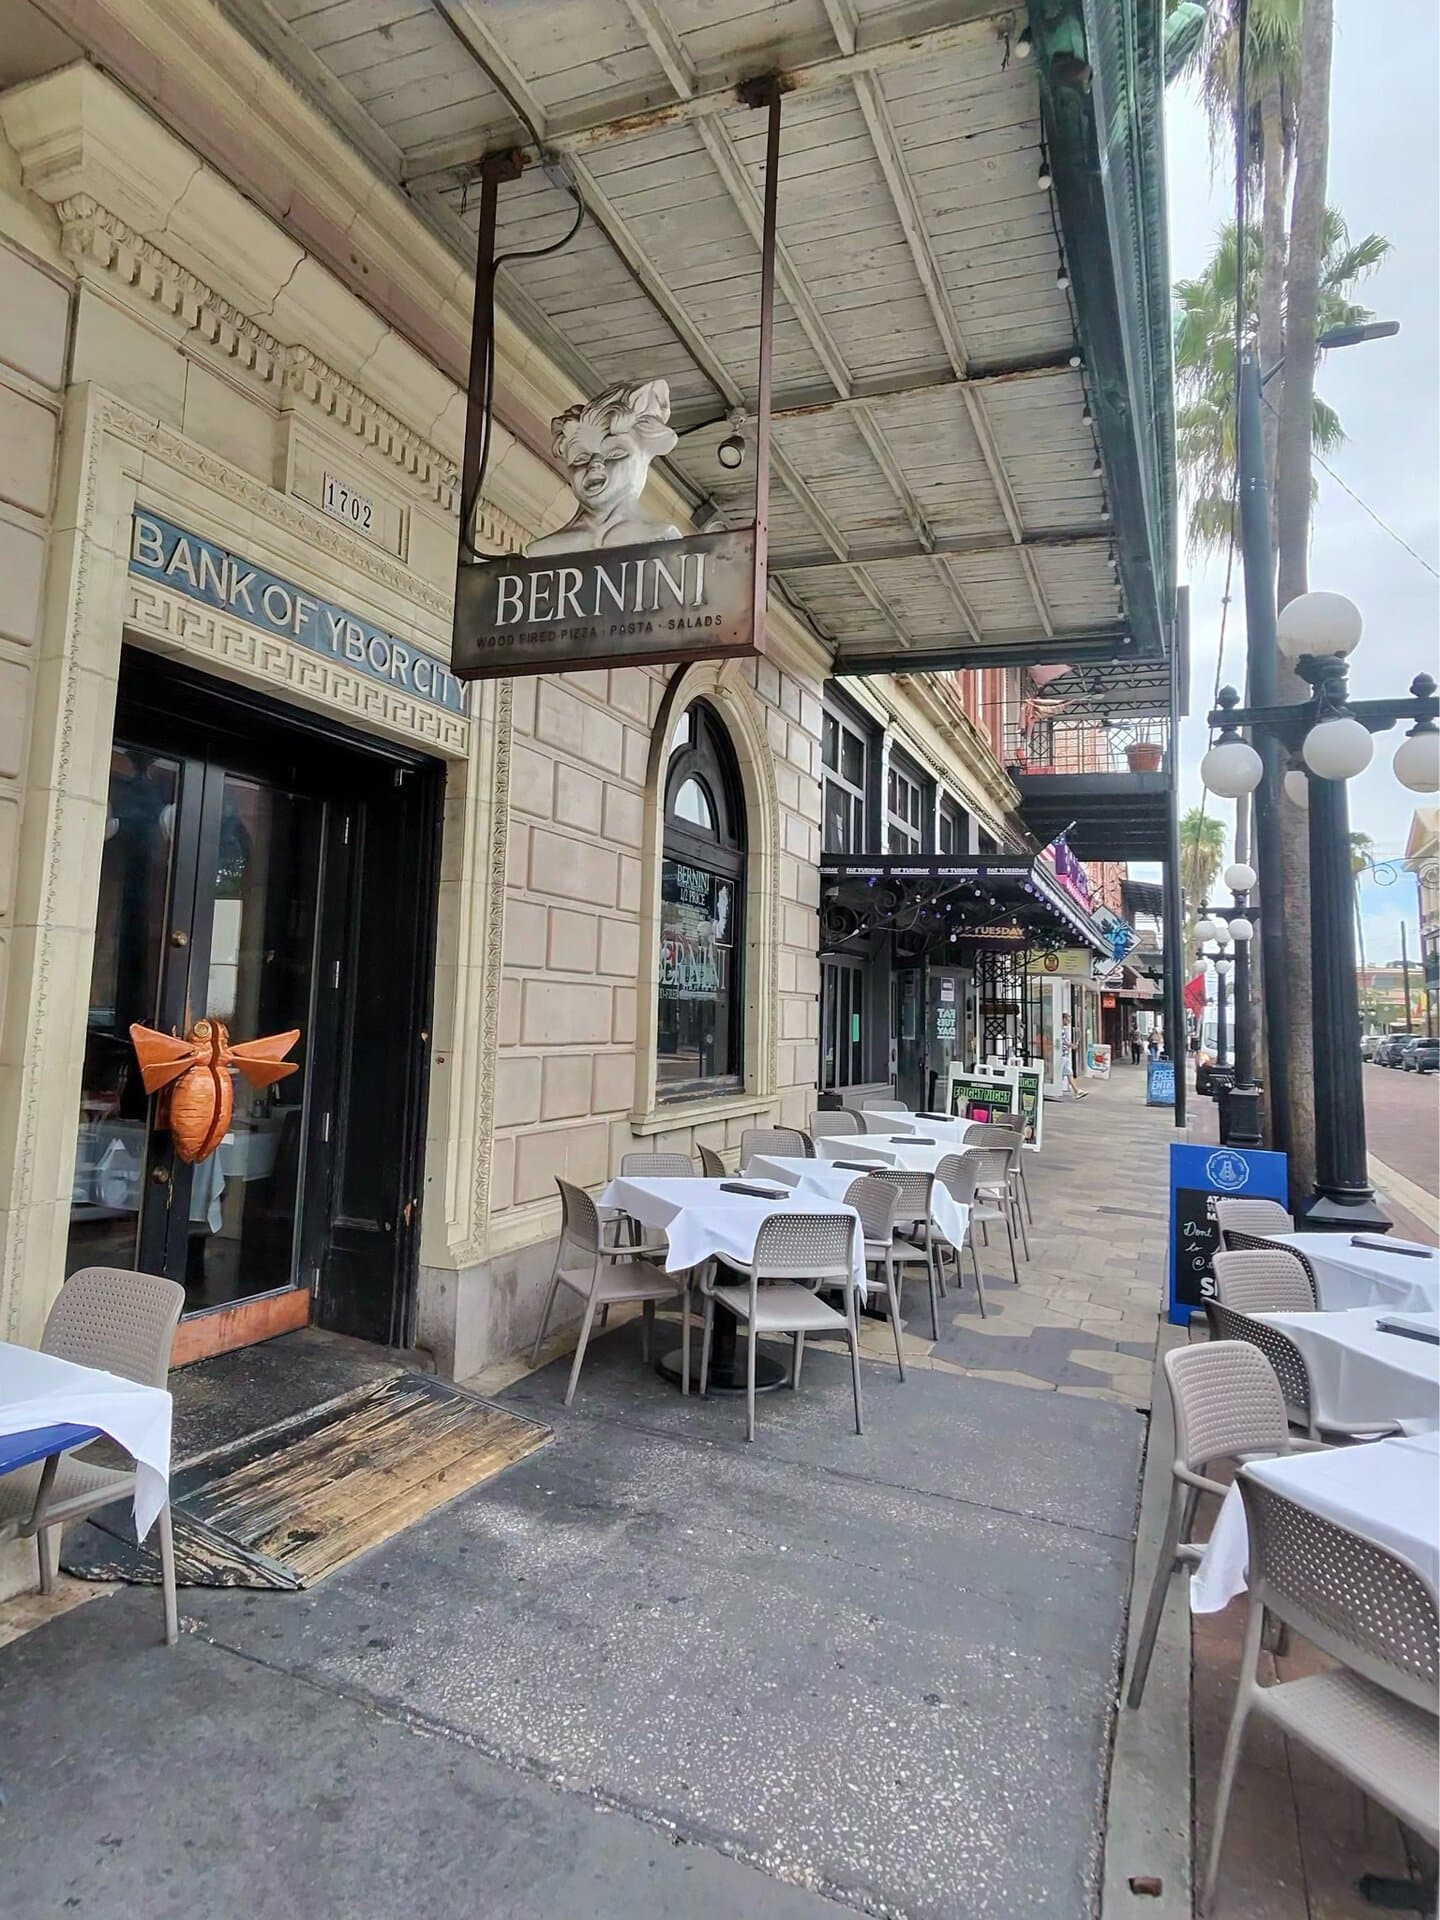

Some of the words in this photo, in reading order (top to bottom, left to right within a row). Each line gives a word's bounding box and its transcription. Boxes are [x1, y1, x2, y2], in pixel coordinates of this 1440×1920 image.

[327, 483, 372, 529] 1702
[494, 552, 707, 627] BERNINI
[133, 515, 257, 615] BANK
[263, 584, 319, 636] OF
[323, 608, 409, 686] YBOR
[412, 658, 470, 711] CITY
[476, 633, 515, 649] WOOD
[519, 629, 556, 645] FIRED
[560, 626, 598, 641] PIZZA
[609, 620, 653, 637] PASTA
[667, 614, 723, 631] SALADS
[677, 864, 710, 892] BERNINI
[974, 926, 1025, 935] TUESDAY
[1019, 1077, 1037, 1088] IGHT
[1153, 1070, 1175, 1080] FREE
[954, 1085, 984, 1101] FRIGHT
[984, 1088, 1012, 1103] NIGHT
